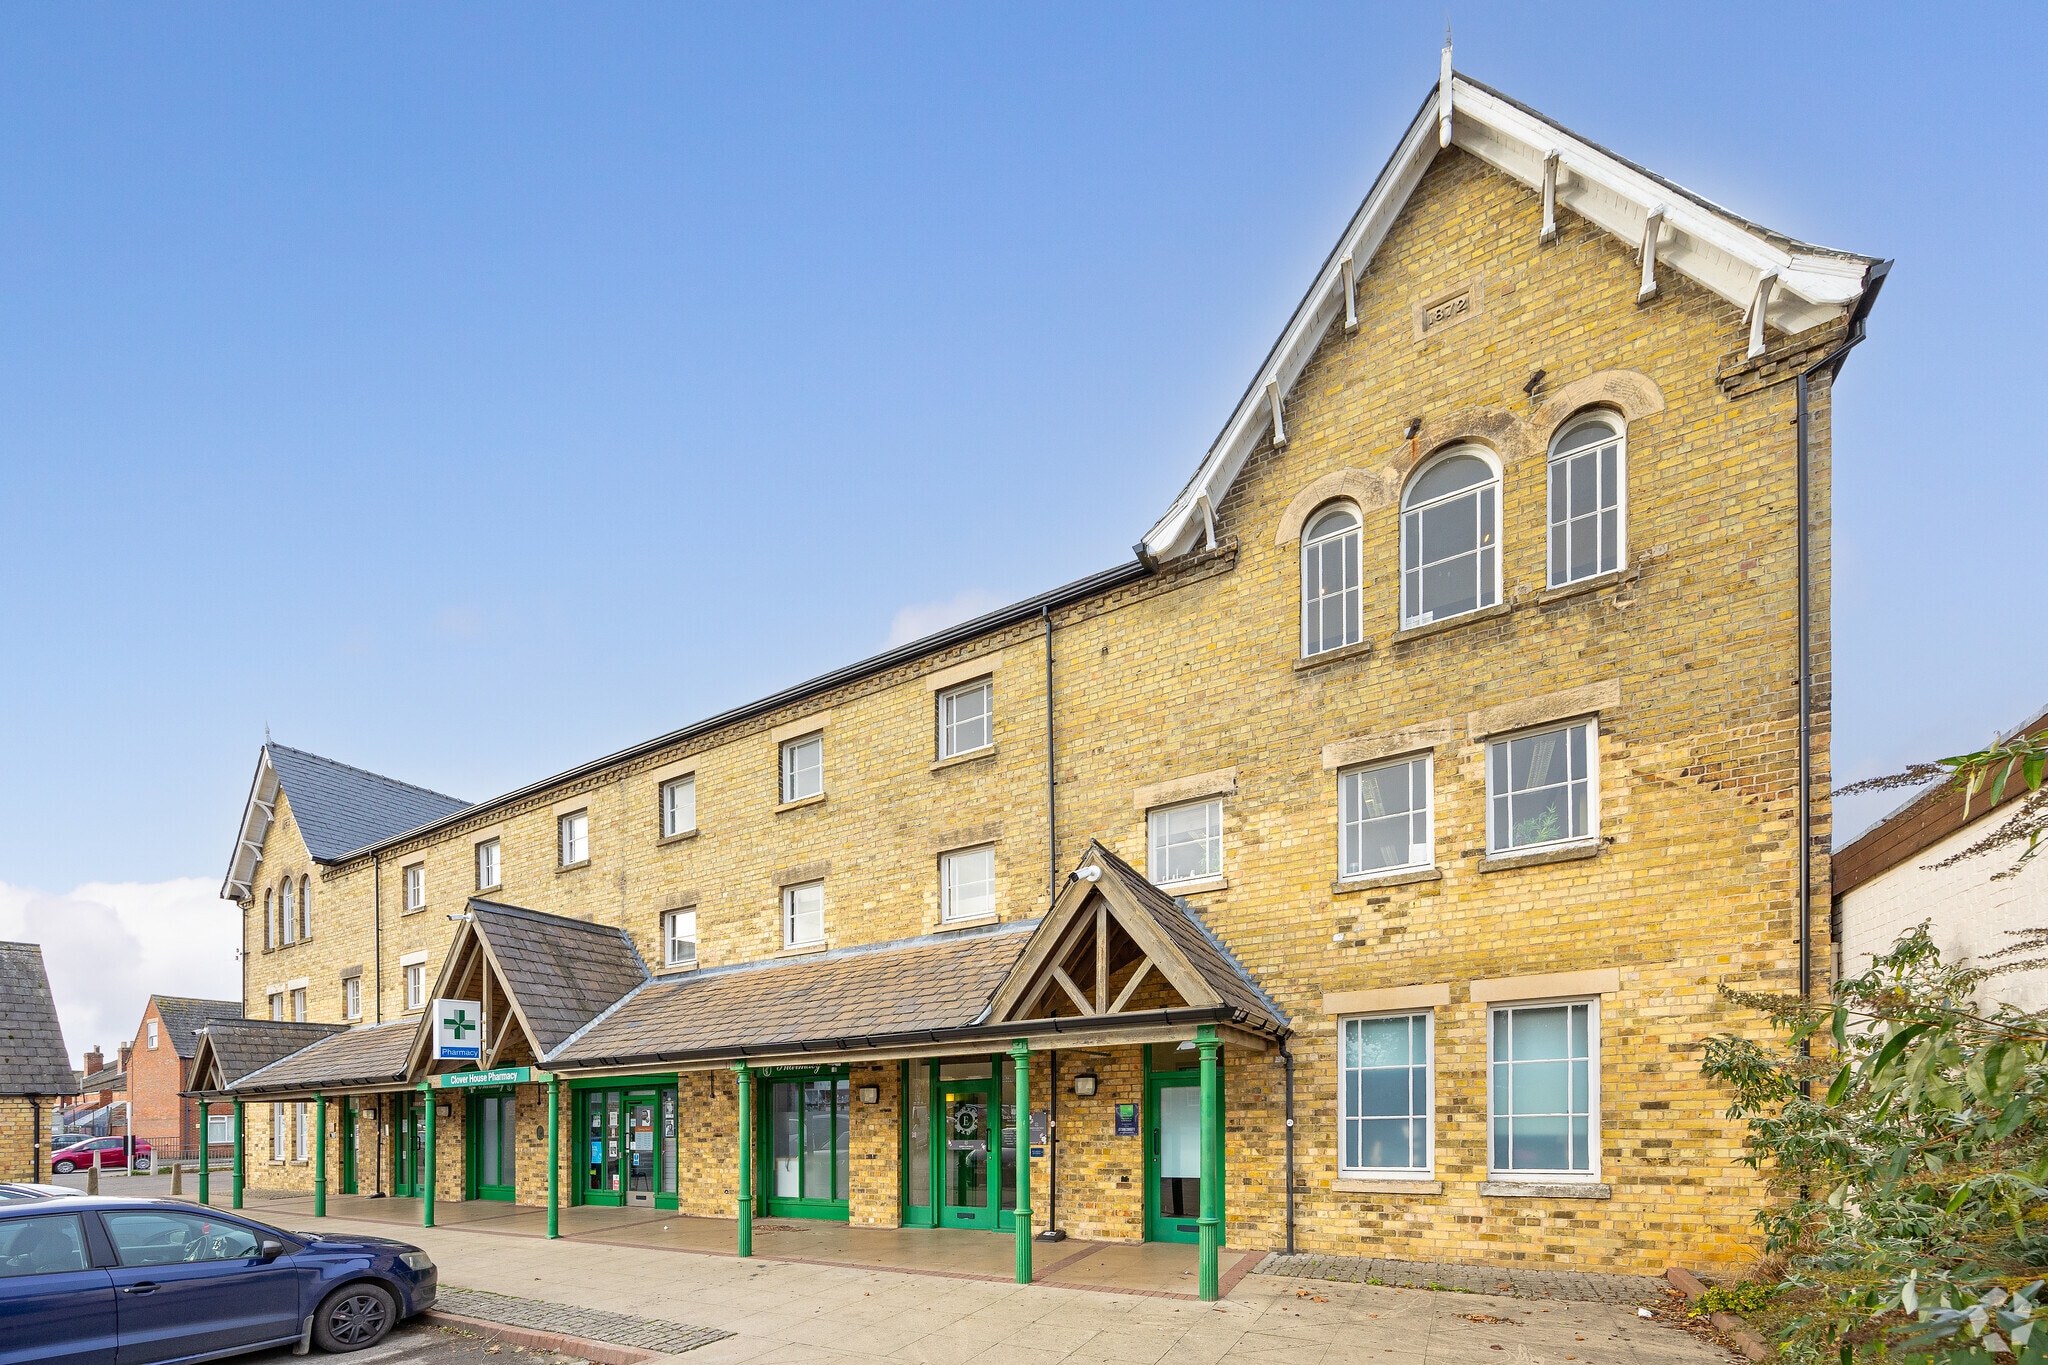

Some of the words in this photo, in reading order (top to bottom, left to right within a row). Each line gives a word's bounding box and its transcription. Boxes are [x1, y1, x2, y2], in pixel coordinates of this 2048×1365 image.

[1428, 299, 1468, 326] 1872
[441, 1048, 479, 1057] Pharmacy
[451, 1075, 468, 1085] Clover
[469, 1073, 487, 1083] House
[488, 1071, 518, 1082] Pharmacy
